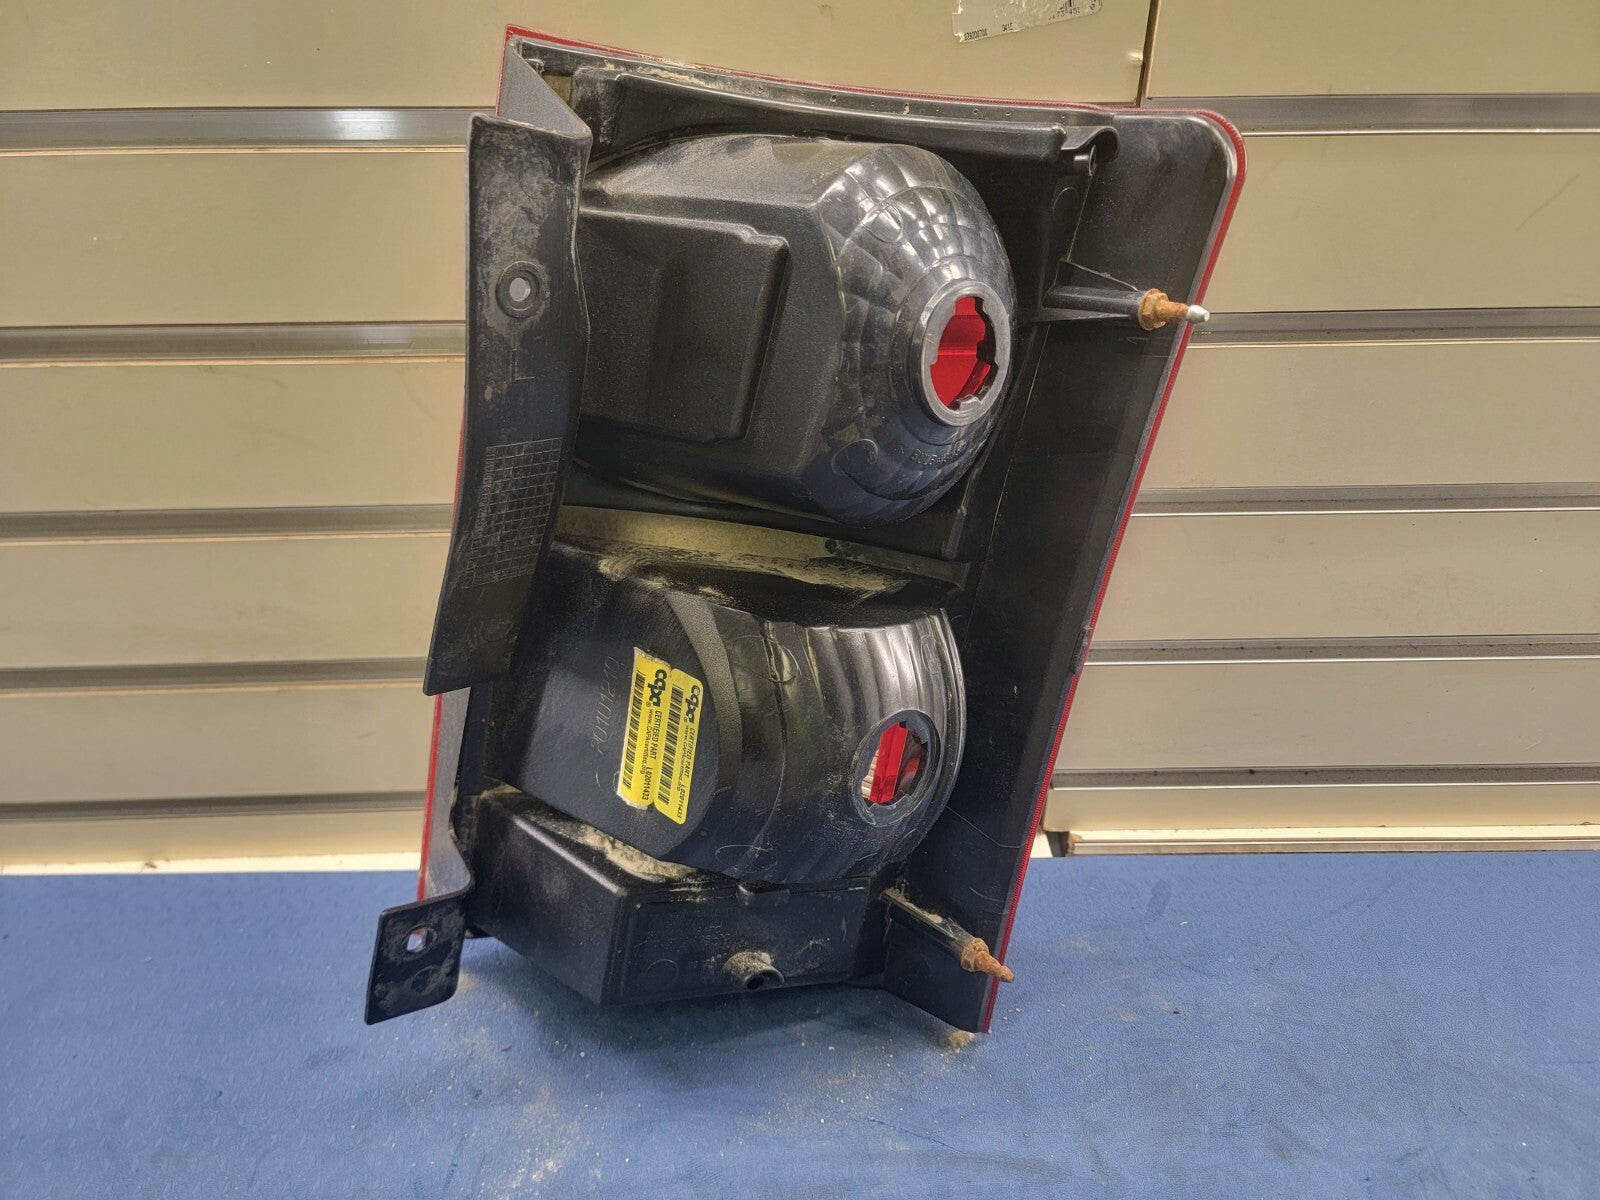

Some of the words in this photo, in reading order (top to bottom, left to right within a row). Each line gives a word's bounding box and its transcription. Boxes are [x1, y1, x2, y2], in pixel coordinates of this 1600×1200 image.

[647, 668, 668, 707] capa
[640, 708, 653, 775] www.CAPAcertified.org
[651, 710, 663, 742] CERTIFIED
[649, 743, 658, 760] PART
[686, 727, 696, 760] CERTIFIED
[641, 767, 653, 801] L02011433
[684, 760, 692, 778] PART
